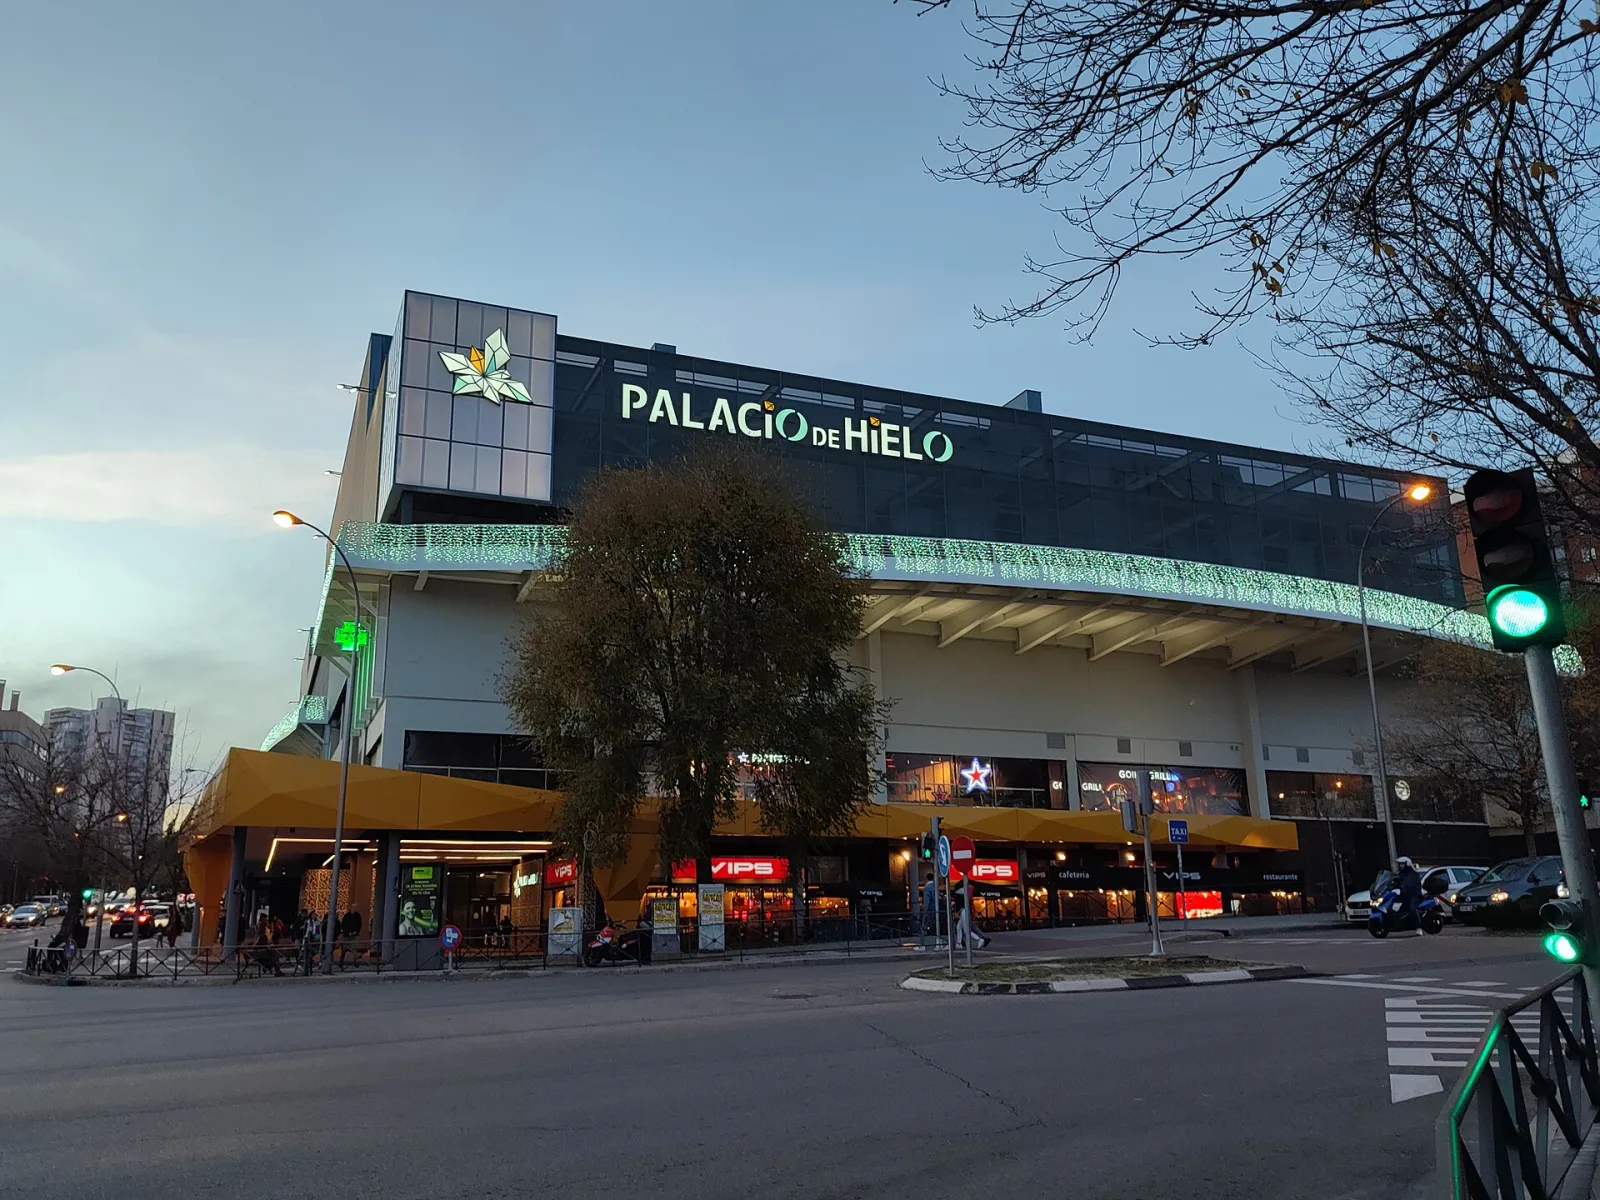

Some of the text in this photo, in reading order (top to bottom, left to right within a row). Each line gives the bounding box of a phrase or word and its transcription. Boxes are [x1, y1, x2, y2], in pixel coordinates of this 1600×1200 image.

[812, 427, 840, 450] DE
[1170, 827, 1187, 836] TAXI
[554, 864, 573, 878] VIPS
[711, 861, 774, 875] VIPS
[958, 864, 1013, 877] IPS
[1026, 871, 1047, 879] VIPS
[1058, 870, 1299, 881] cafeteria VIPS restaurante
